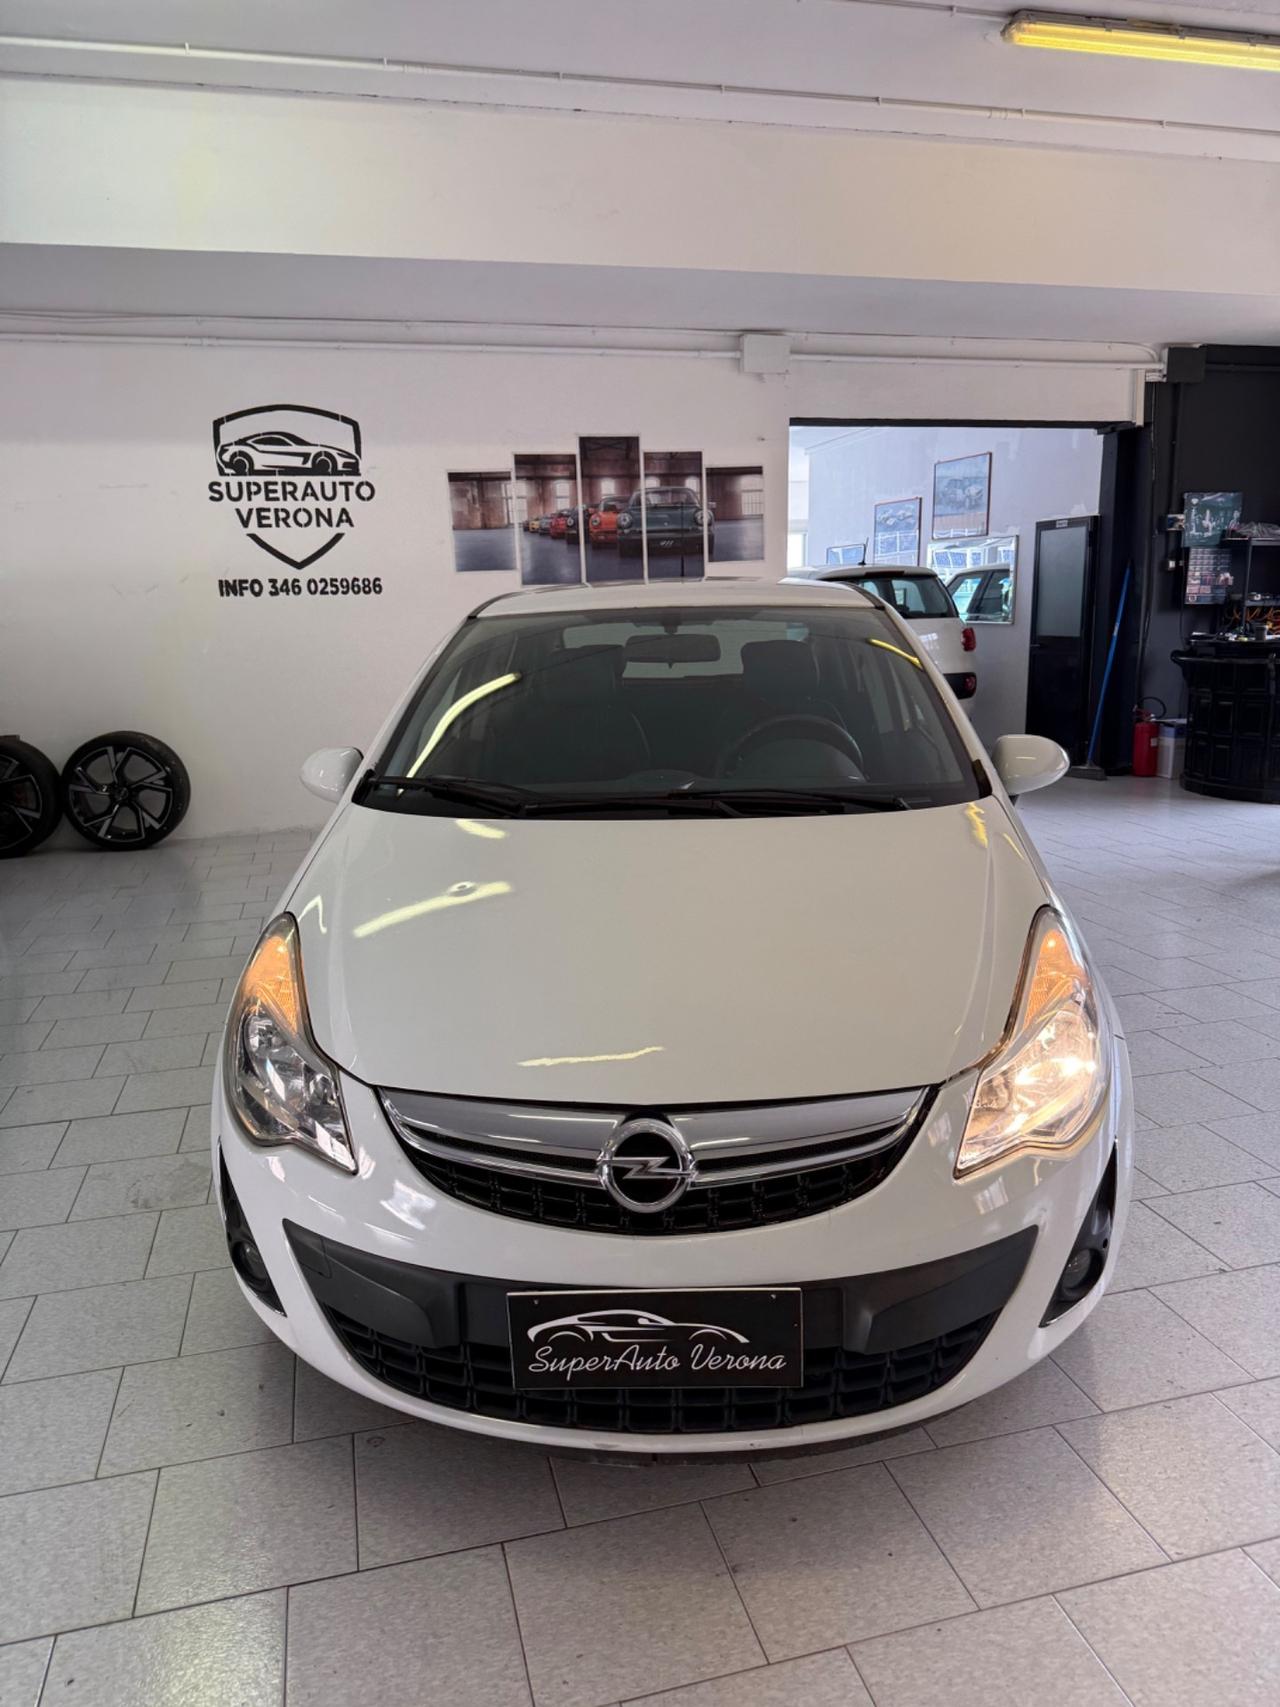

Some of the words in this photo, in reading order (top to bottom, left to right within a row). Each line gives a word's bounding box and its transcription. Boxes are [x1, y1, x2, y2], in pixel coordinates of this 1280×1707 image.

[208, 481, 376, 502] SUPERAUTO
[235, 507, 355, 528] VERONA
[218, 579, 263, 597] INFO
[268, 578, 302, 596] 346
[307, 577, 383, 596] 0259686
[528, 1344, 680, 1381] SuperAuto
[690, 1343, 786, 1371] Verona
